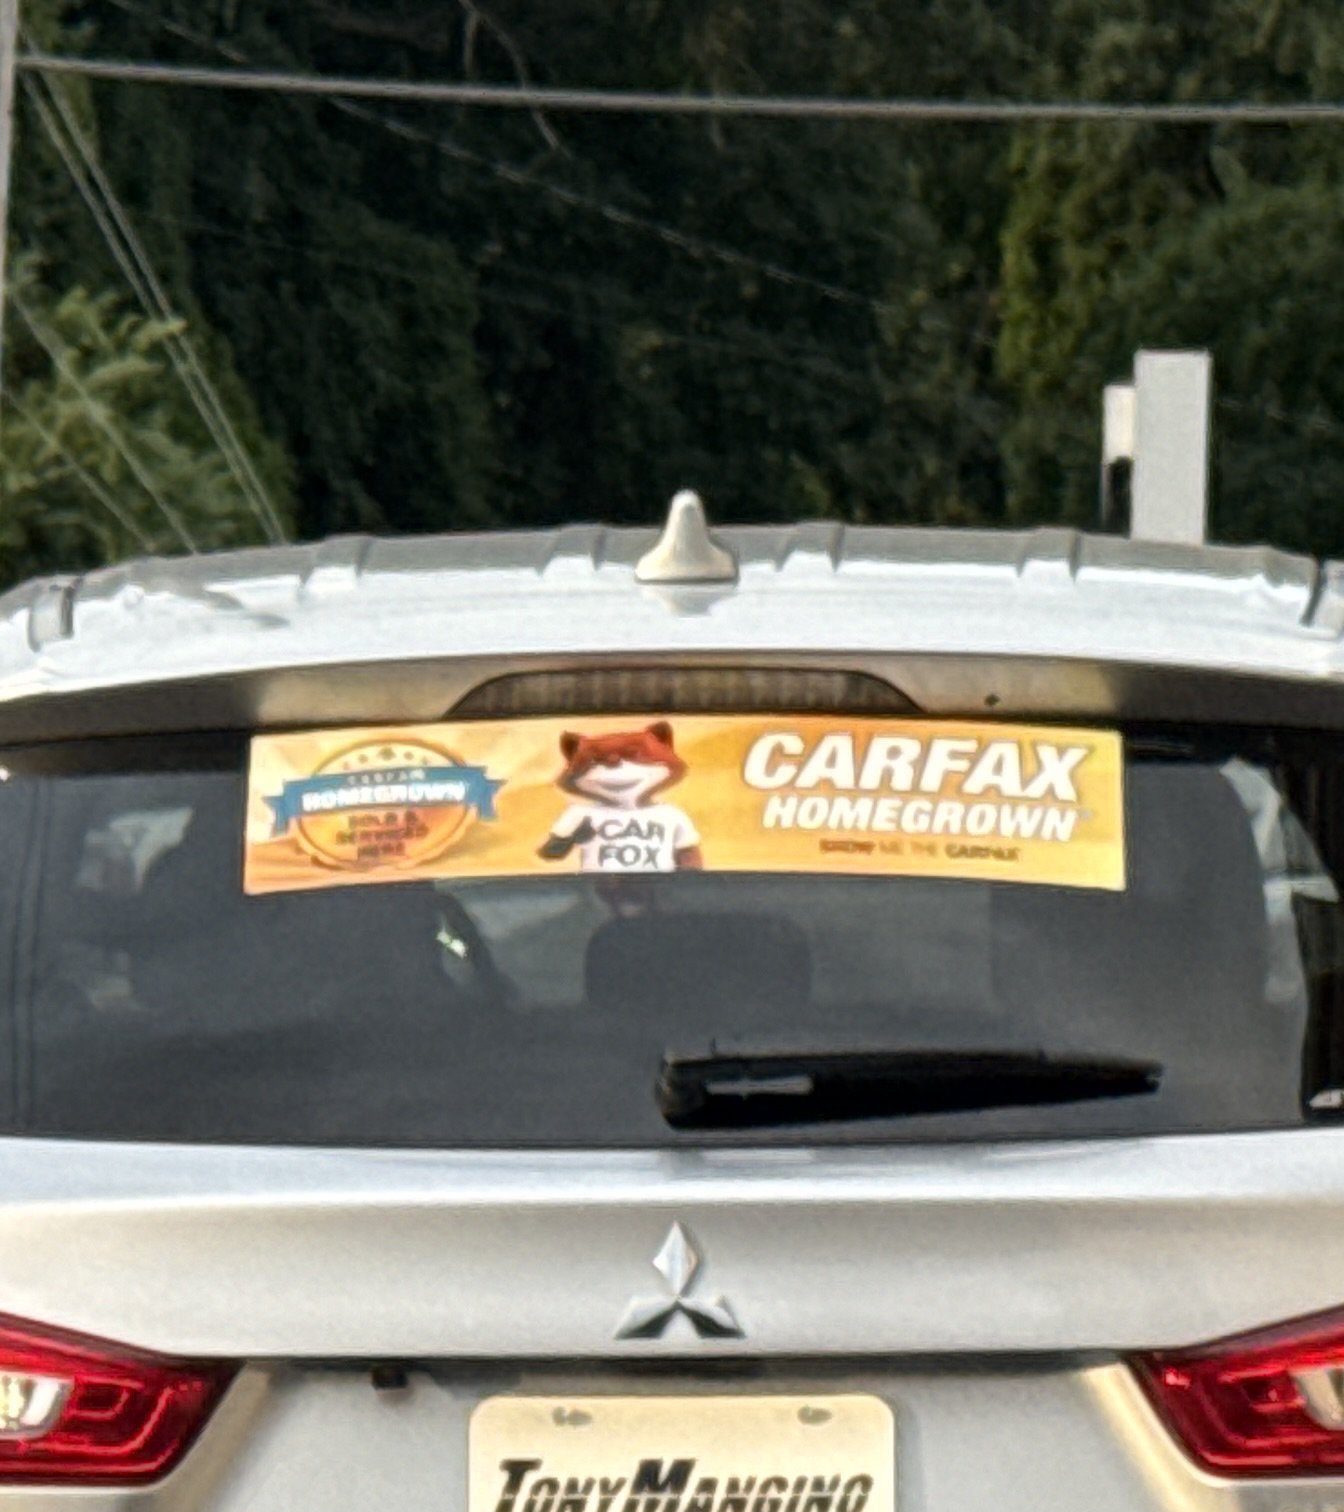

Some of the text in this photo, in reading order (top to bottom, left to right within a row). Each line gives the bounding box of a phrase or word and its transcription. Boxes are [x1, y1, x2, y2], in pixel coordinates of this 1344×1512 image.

[742, 730, 1090, 802] CARFAX
[598, 817, 665, 844] CAR
[762, 794, 1080, 842] HOMEGROWN
[598, 843, 660, 868] FOX
